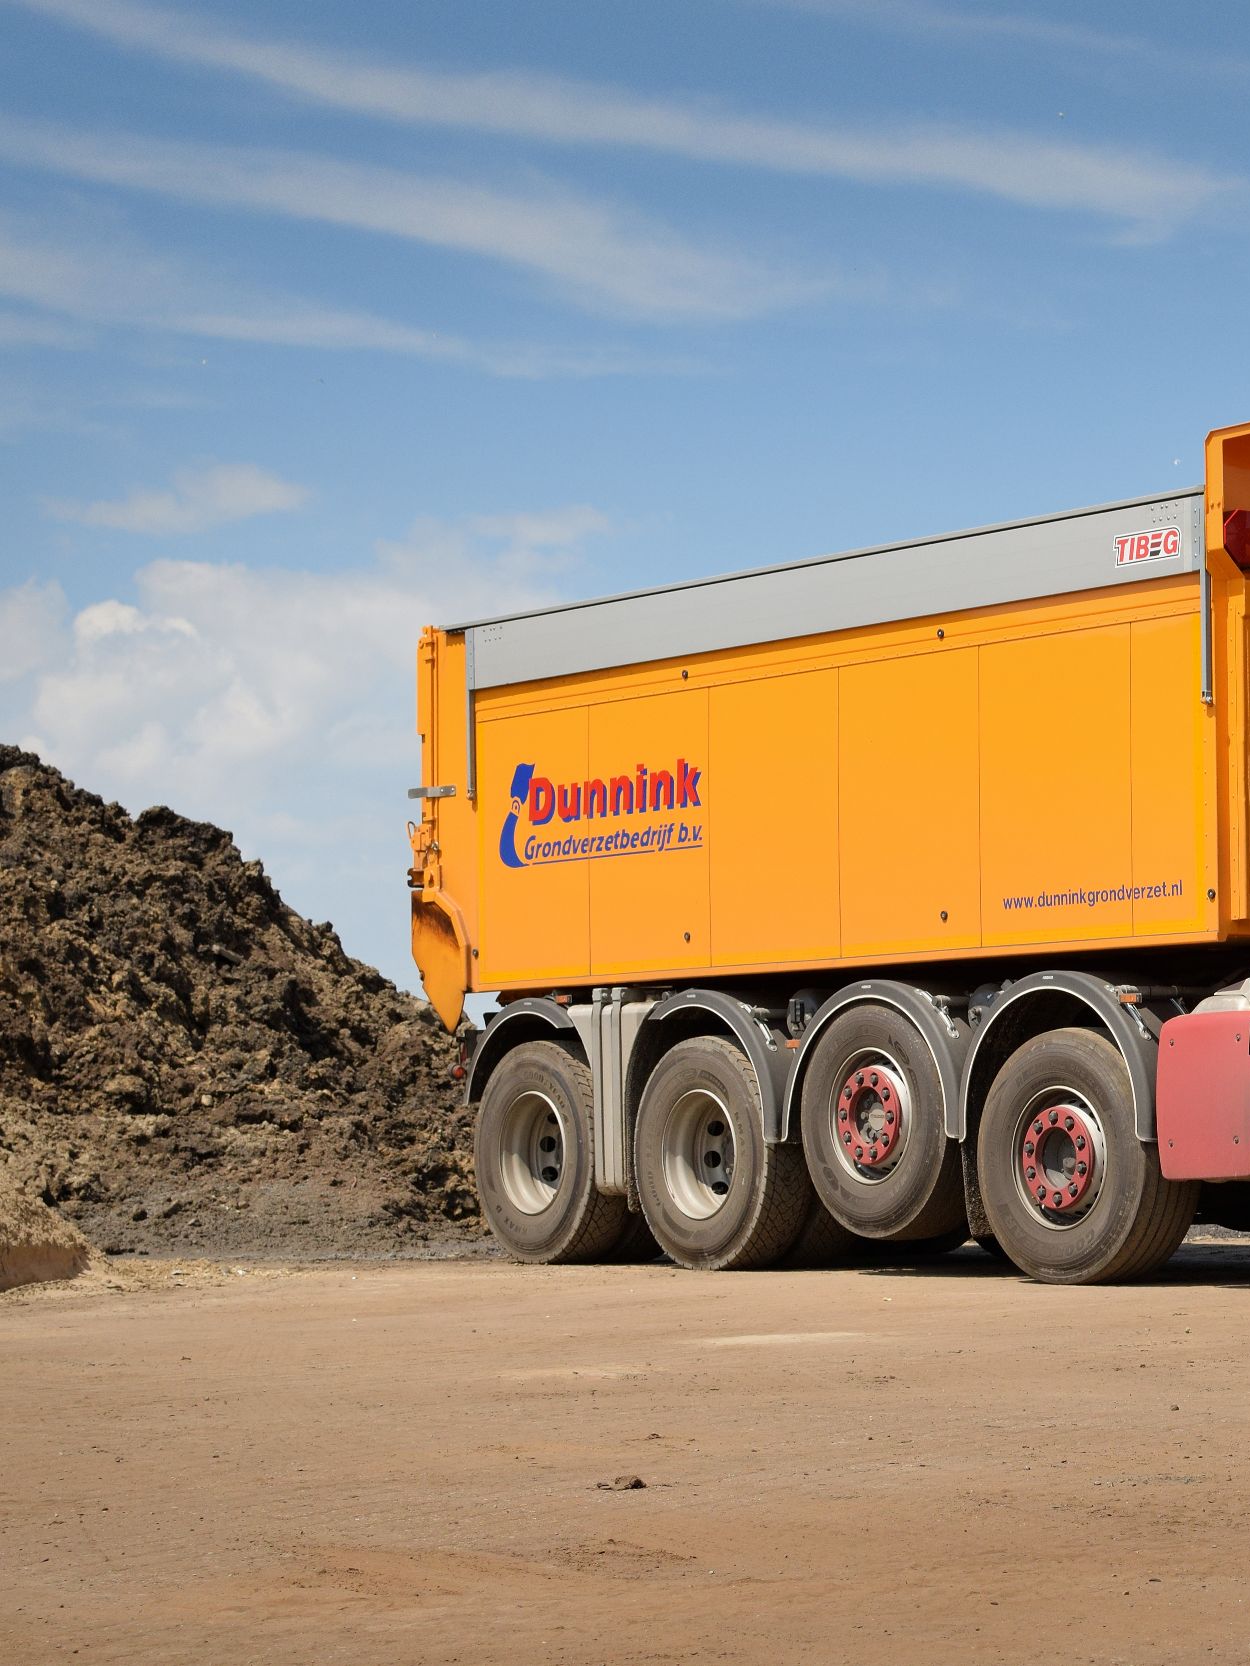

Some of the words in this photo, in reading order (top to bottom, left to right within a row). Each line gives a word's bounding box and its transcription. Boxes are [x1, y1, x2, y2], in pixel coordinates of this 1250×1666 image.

[1117, 530, 1178, 562] TIBEG
[529, 758, 702, 825] Dunnink
[524, 823, 675, 860] Grondverzetbedrijf
[678, 822, 703, 843] b.v.
[1003, 880, 1183, 910] www.dunninkgrondverzet.nl
